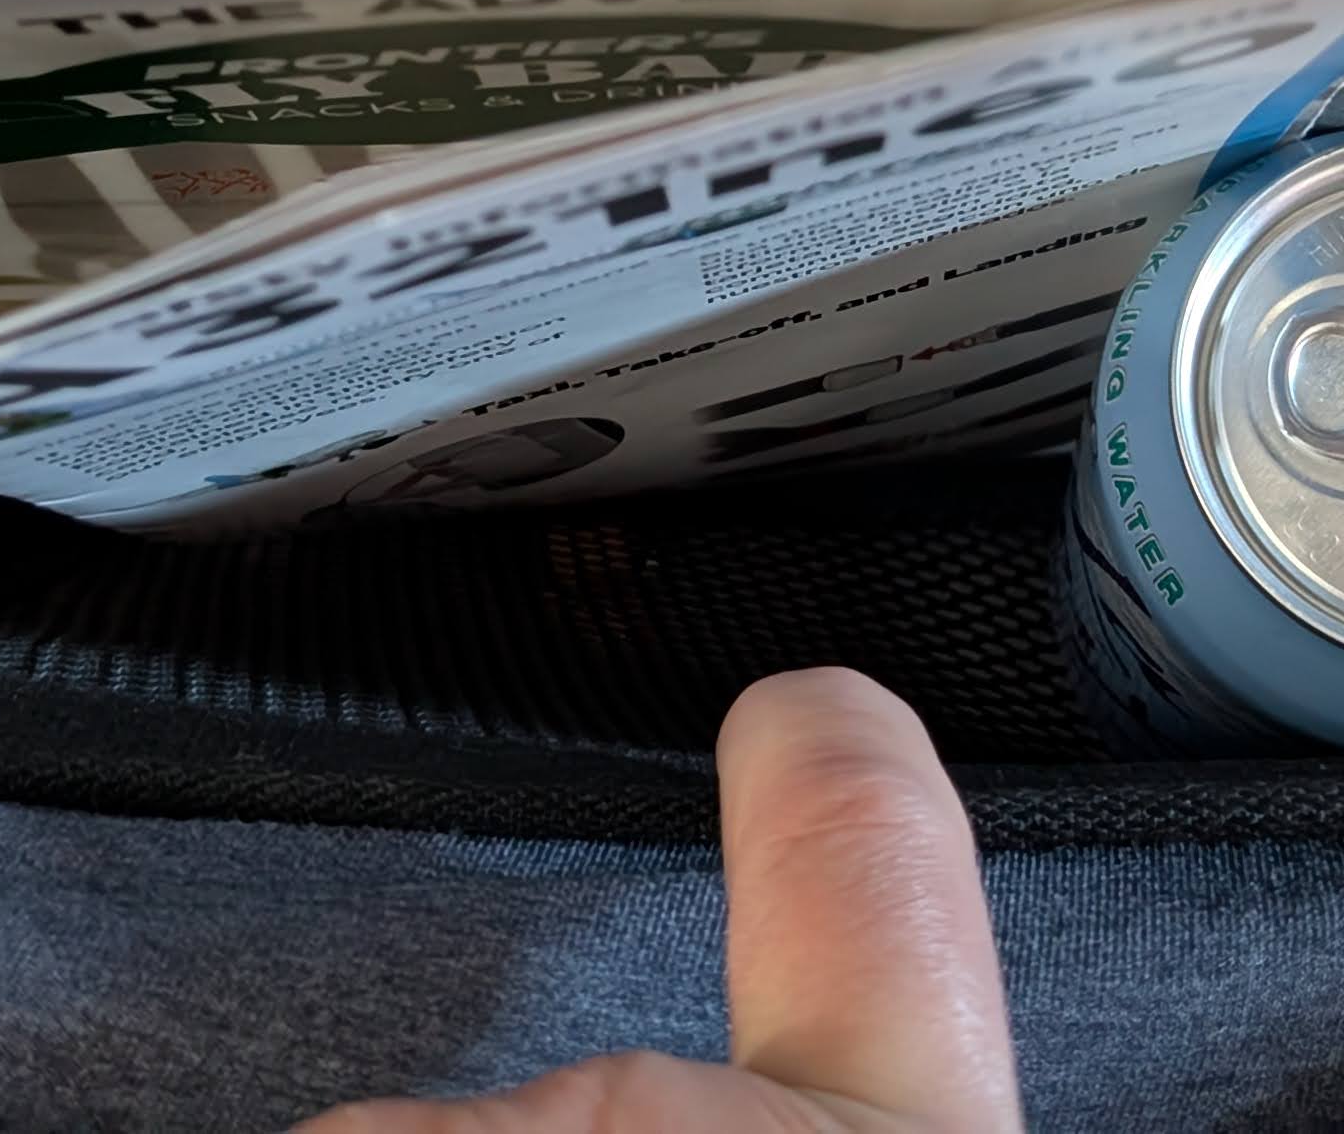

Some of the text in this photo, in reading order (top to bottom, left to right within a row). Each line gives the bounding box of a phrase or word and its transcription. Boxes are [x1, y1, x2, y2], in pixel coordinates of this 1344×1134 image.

[146, 29, 768, 81] FRONTIER'S
[64, 70, 389, 119] FLY
[166, 80, 741, 128] SNACKS & DRIN
[957, 199, 1023, 223] con
[705, 254, 858, 305] nuestros
[459, 213, 1149, 421] Taxi, Take-off, and Landing
[447, 346, 516, 370] one
[527, 330, 564, 347] of
[105, 459, 163, 482] our
[1106, 421, 1185, 607] WATER
